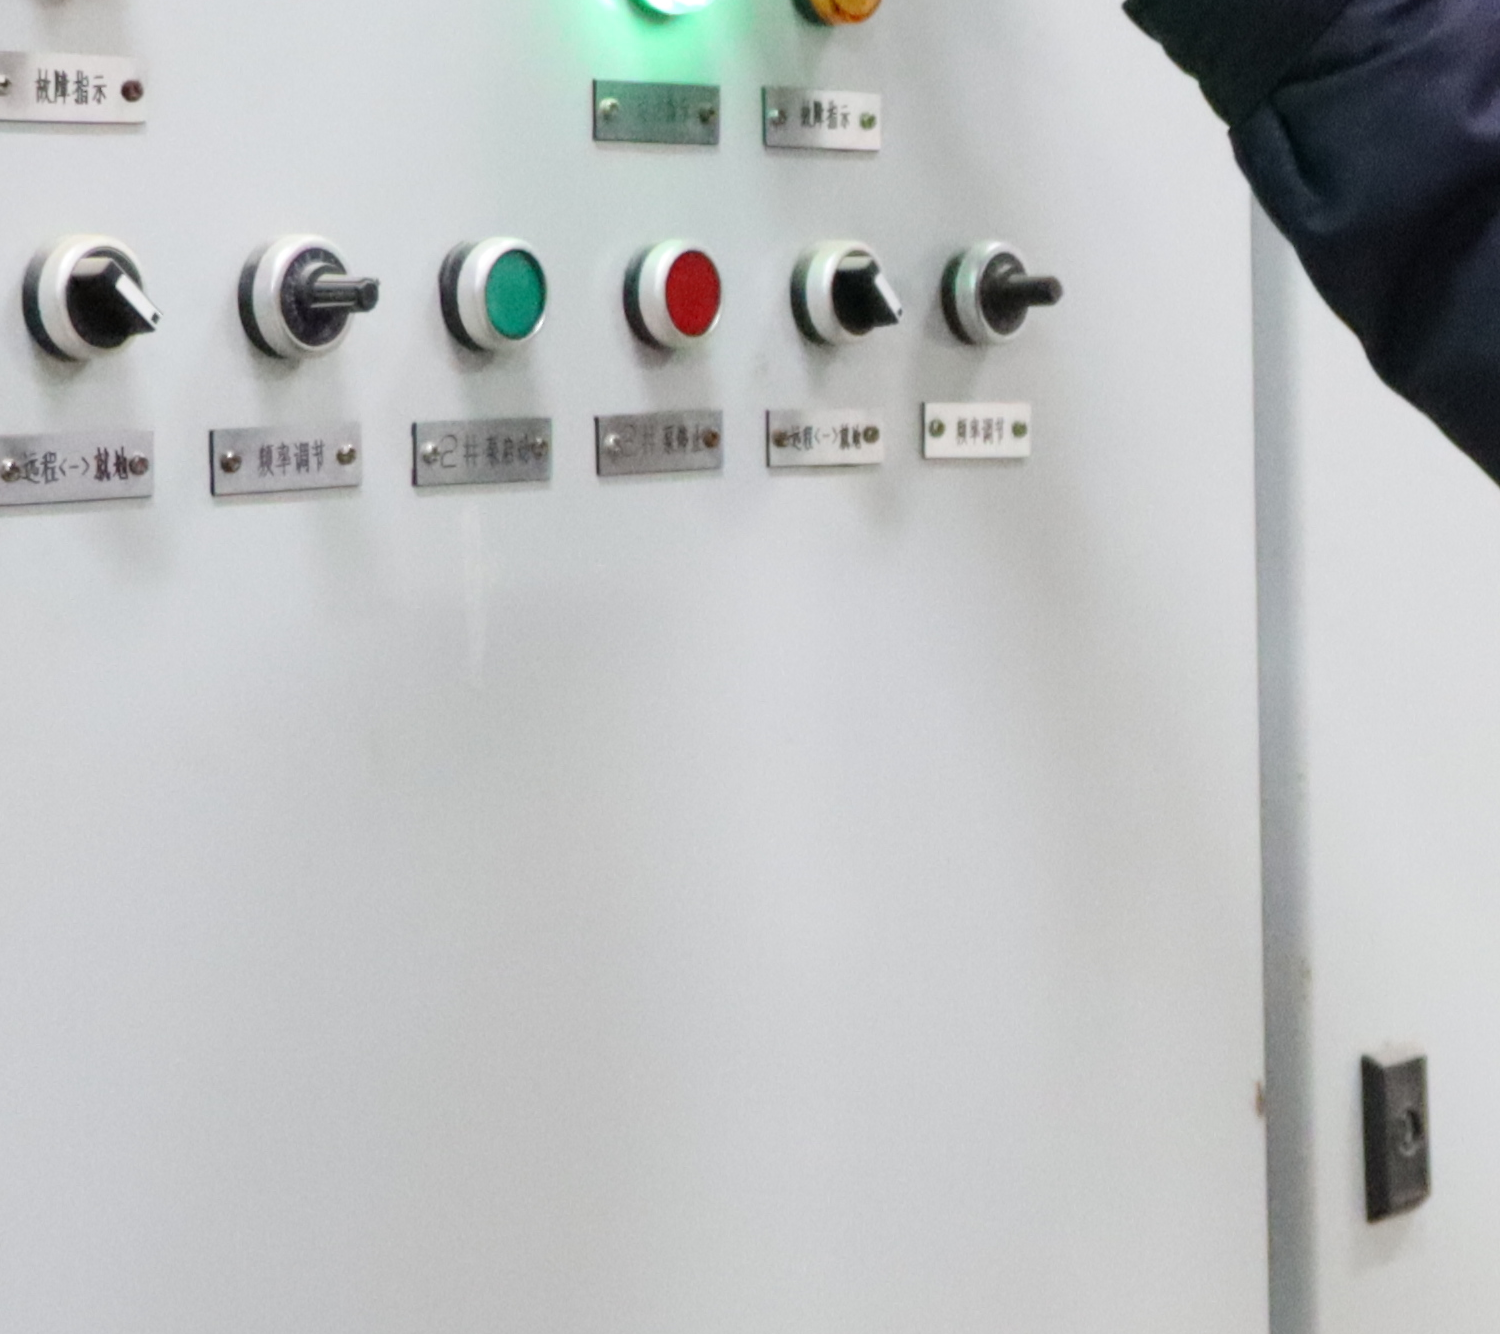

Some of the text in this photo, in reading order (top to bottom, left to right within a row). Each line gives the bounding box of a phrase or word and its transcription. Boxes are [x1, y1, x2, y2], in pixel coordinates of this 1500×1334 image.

[34, 68, 108, 107] 故障指示
[256, 439, 326, 478] 频率调节
[439, 433, 479, 468] 2#
